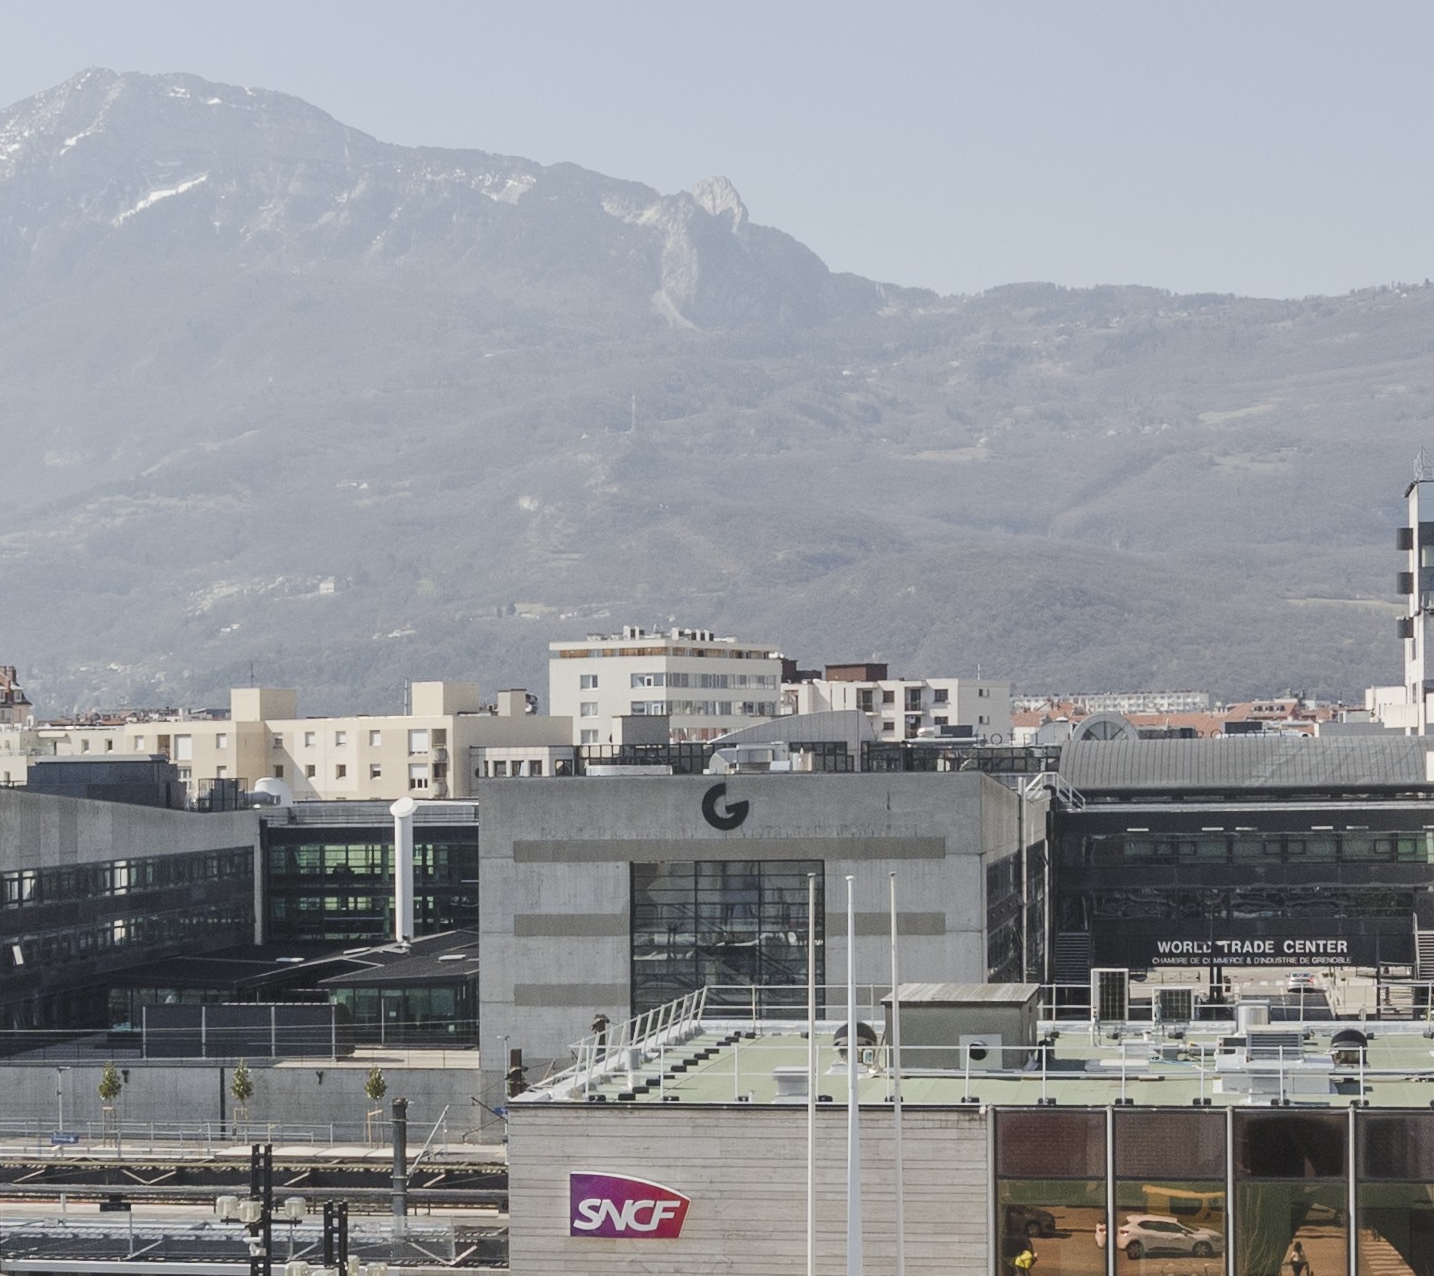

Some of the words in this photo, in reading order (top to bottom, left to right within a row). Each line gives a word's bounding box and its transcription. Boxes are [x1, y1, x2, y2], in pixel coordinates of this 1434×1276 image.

[1157, 940, 1212, 954] WORLD
[1221, 940, 1275, 954] TRADE
[1283, 940, 1348, 954] CENTER
[1152, 957, 1189, 965] CHAMBRE
[1190, 957, 1200, 965] DE
[1299, 956, 1310, 964] DE
[1312, 956, 1352, 964] GRENOBLE
[573, 1198, 681, 1231] SNCF
